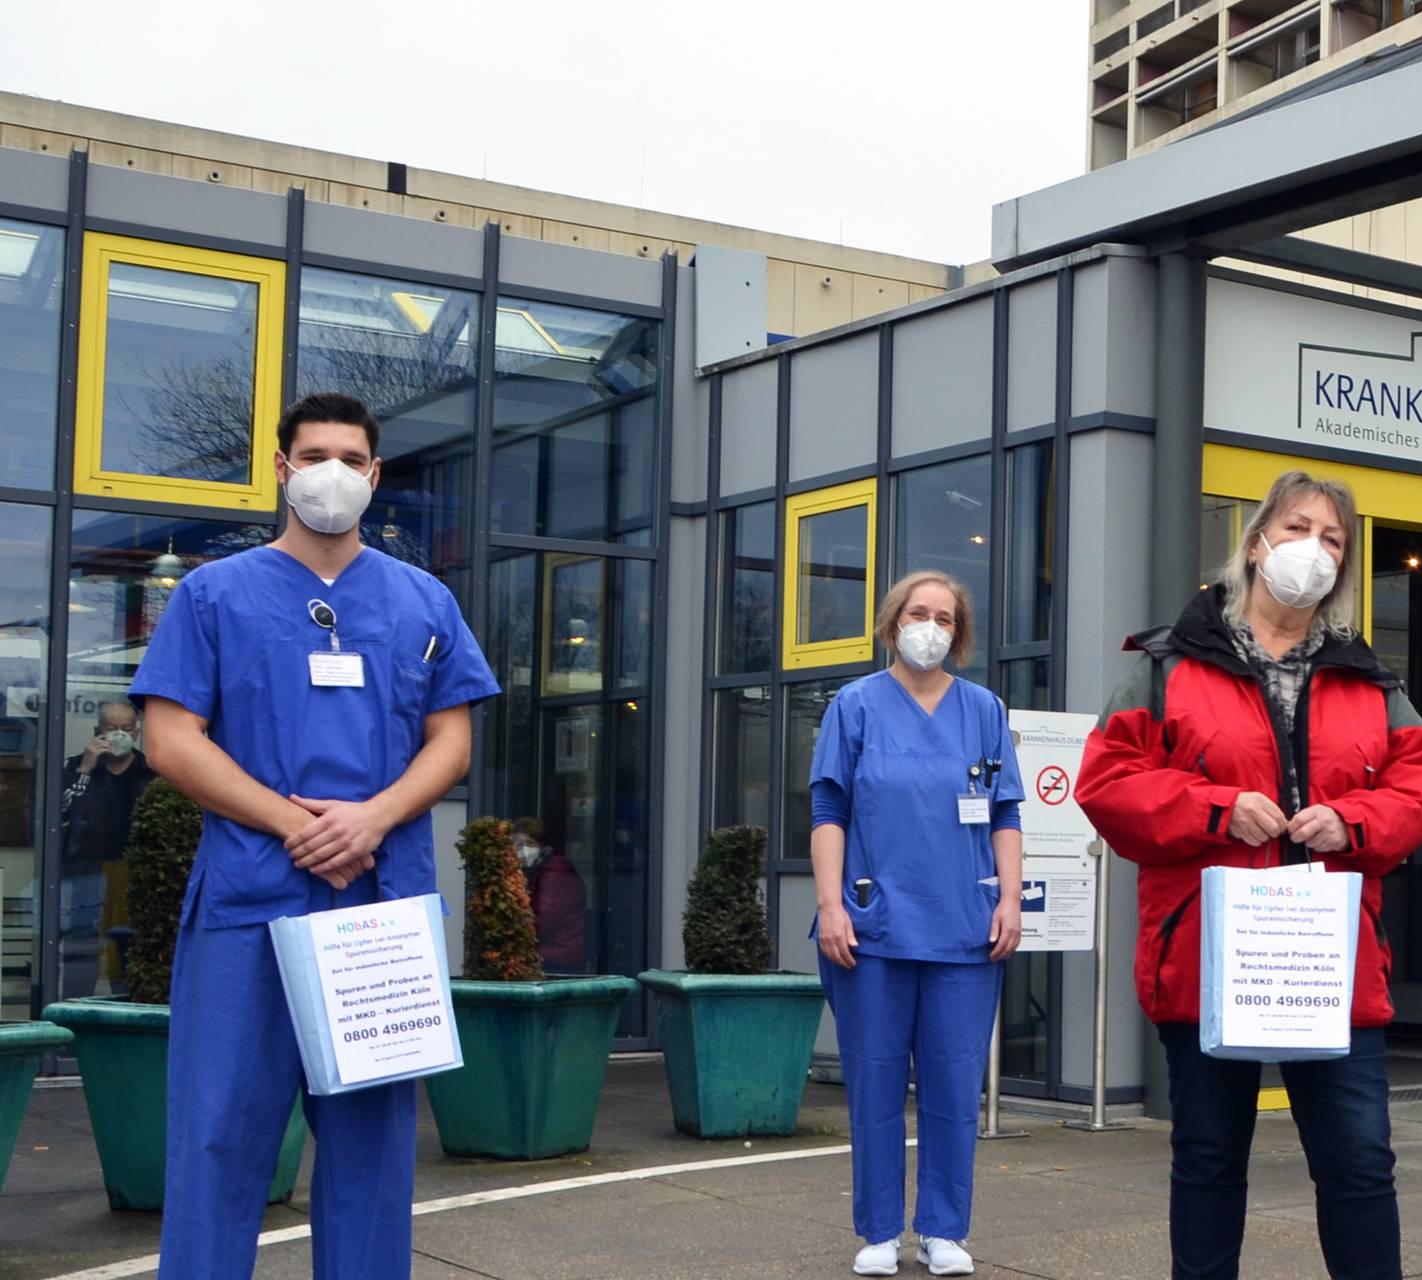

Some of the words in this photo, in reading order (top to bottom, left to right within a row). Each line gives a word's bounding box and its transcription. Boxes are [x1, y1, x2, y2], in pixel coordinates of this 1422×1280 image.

[1315, 417, 1420, 448] Akademisches
[1250, 885, 1293, 897] HObAS
[1264, 905, 1284, 913] Opfer
[1299, 906, 1336, 914] Anonymer
[336, 918, 378, 934] HObAS
[1252, 915, 1314, 924] Spurensicherung
[342, 940, 352, 948] für
[354, 939, 373, 947] Opfer
[387, 931, 420, 941] Anonymer
[345, 944, 403, 959] Spurensicherung
[1235, 949, 1268, 958] Spuren
[1271, 950, 1289, 958] und
[1291, 951, 1325, 959] Proben
[1240, 962, 1310, 972] Rechtsmedizin
[1313, 963, 1335, 972] Köln
[335, 985, 367, 996] Spuren
[388, 975, 419, 986] Proben
[1251, 978, 1273, 986] MKD
[1283, 979, 1343, 987] Kurierdienst
[342, 991, 408, 1008] Rechtsmedizin
[411, 986, 431, 995] Köln
[1235, 994, 1271, 1006] 0800
[1276, 995, 1341, 1007] 4969690
[338, 1015, 352, 1023] mit
[355, 1011, 376, 1020] MKD
[385, 1000, 440, 1015] Kurierdienst
[343, 1027, 378, 1043] 0800
[382, 1015, 441, 1035] 4969690
